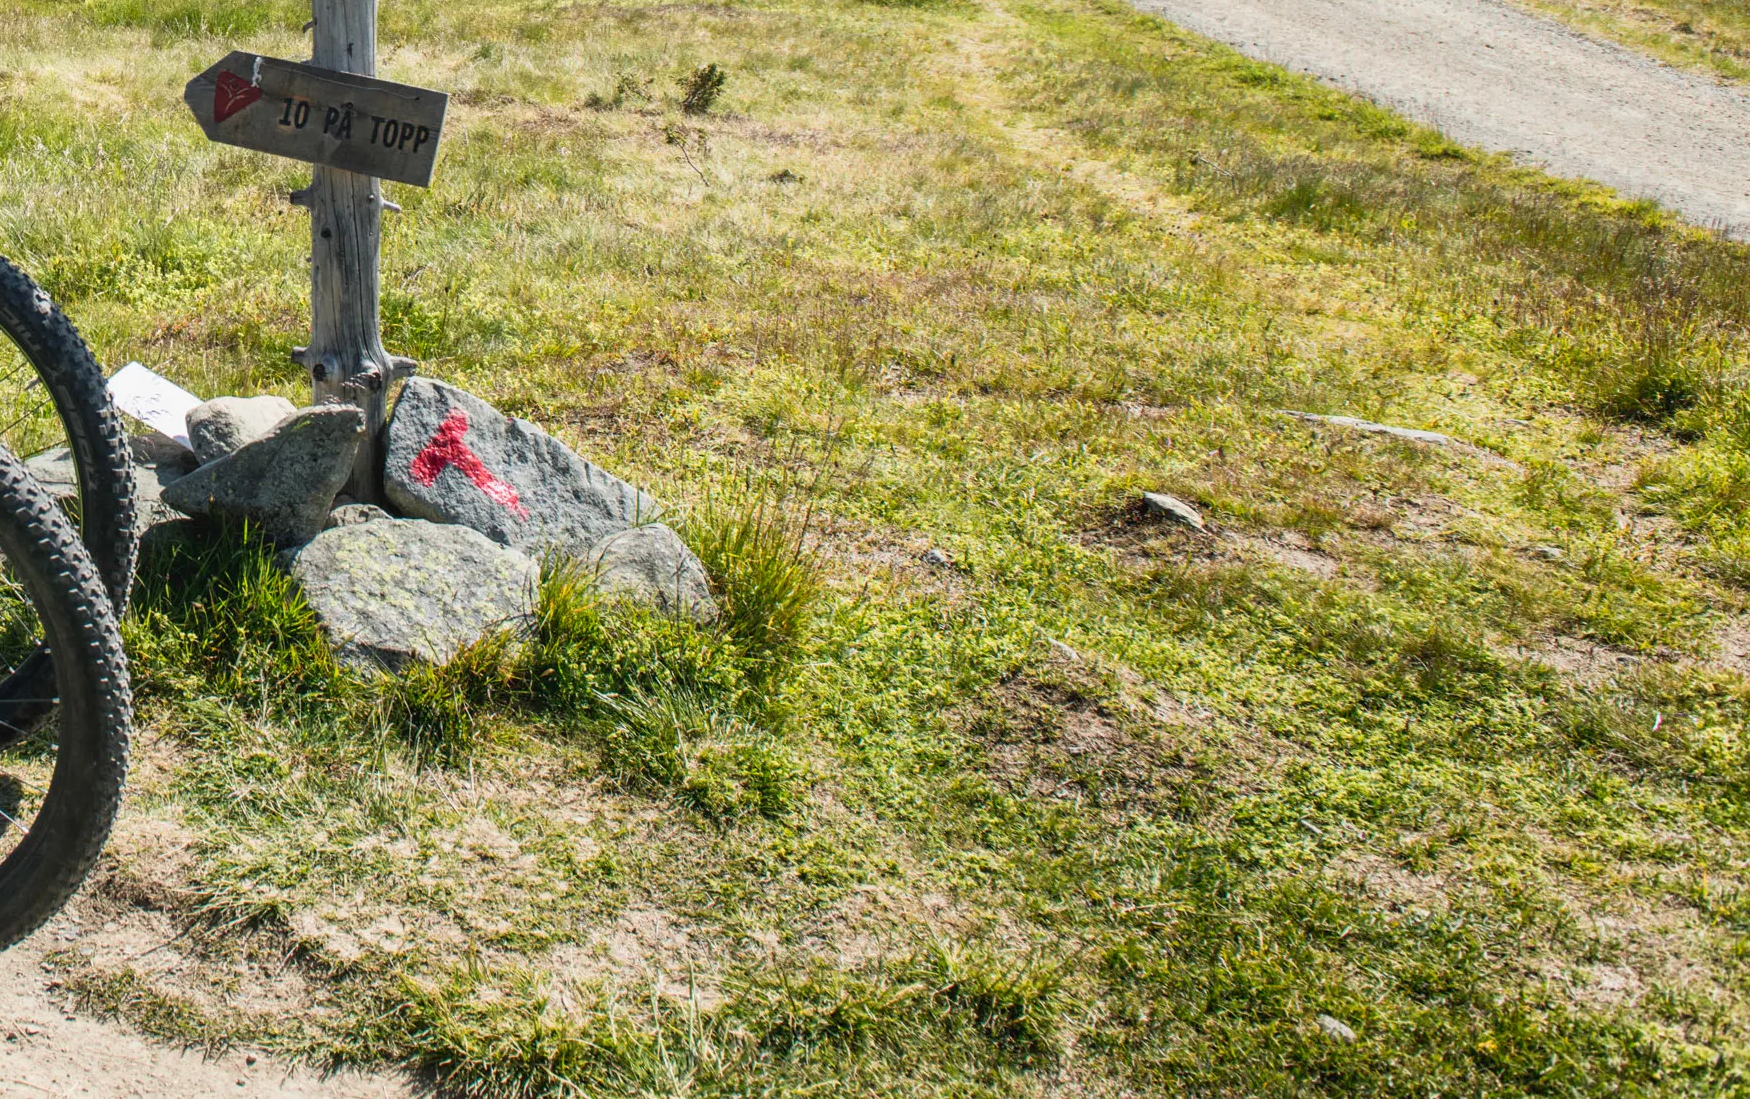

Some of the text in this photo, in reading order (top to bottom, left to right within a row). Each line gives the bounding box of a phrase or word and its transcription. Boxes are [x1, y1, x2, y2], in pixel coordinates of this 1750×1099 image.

[278, 97, 430, 153] 10 PÅ TOPP
